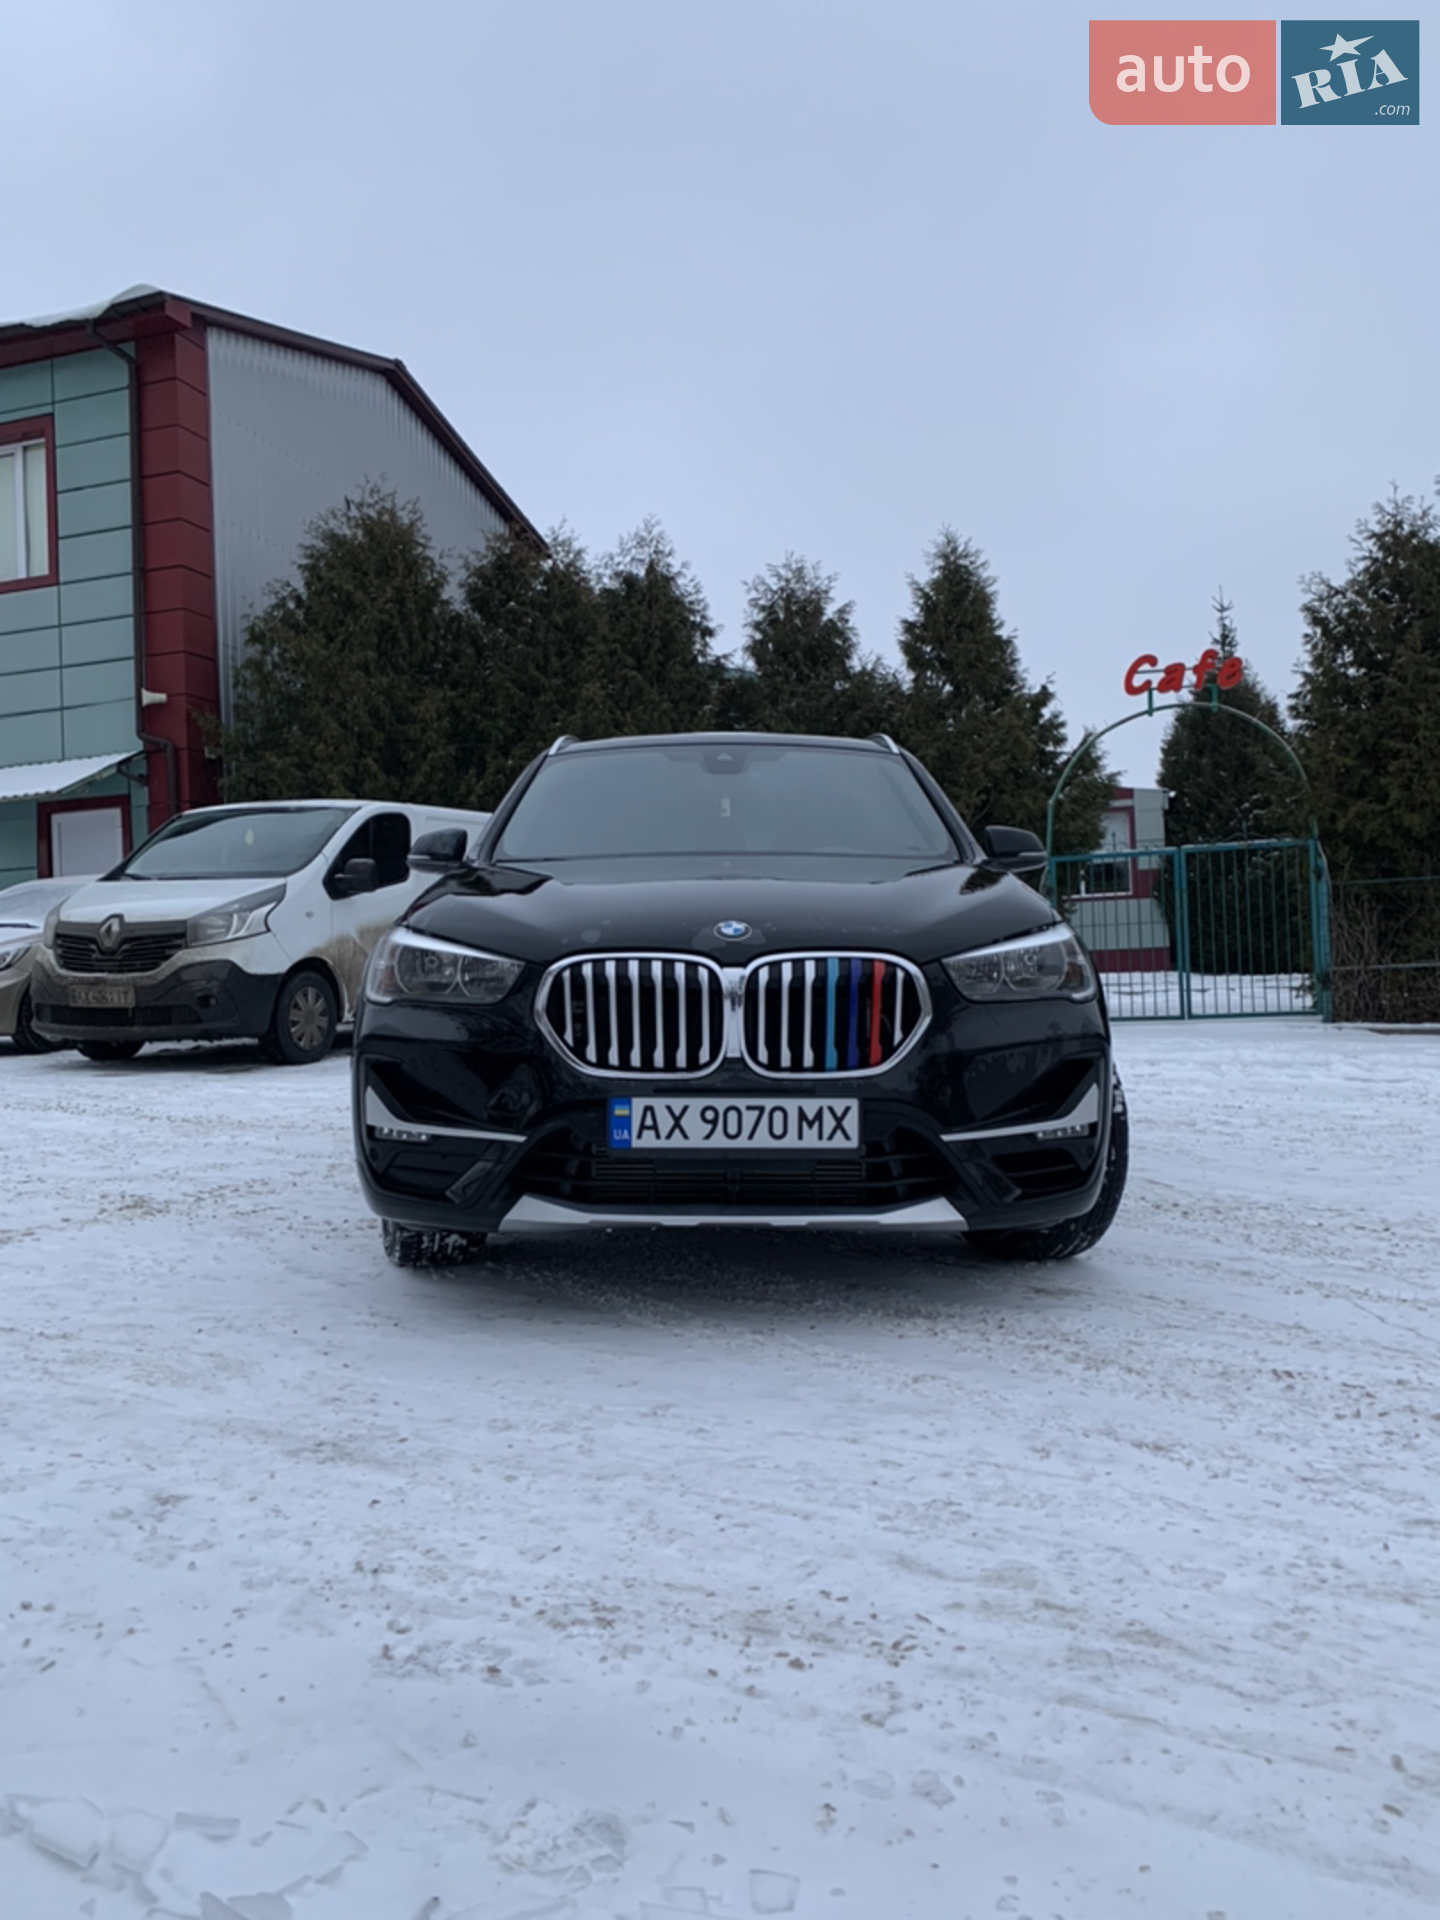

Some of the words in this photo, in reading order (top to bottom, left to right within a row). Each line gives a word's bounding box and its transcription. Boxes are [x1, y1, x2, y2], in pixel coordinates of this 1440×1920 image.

[1123, 648, 1243, 696] Cafe
[613, 1129, 630, 1141] UA
[636, 1104, 691, 1141] AX
[699, 1104, 789, 1141] 9070
[797, 1105, 853, 1142] MX
